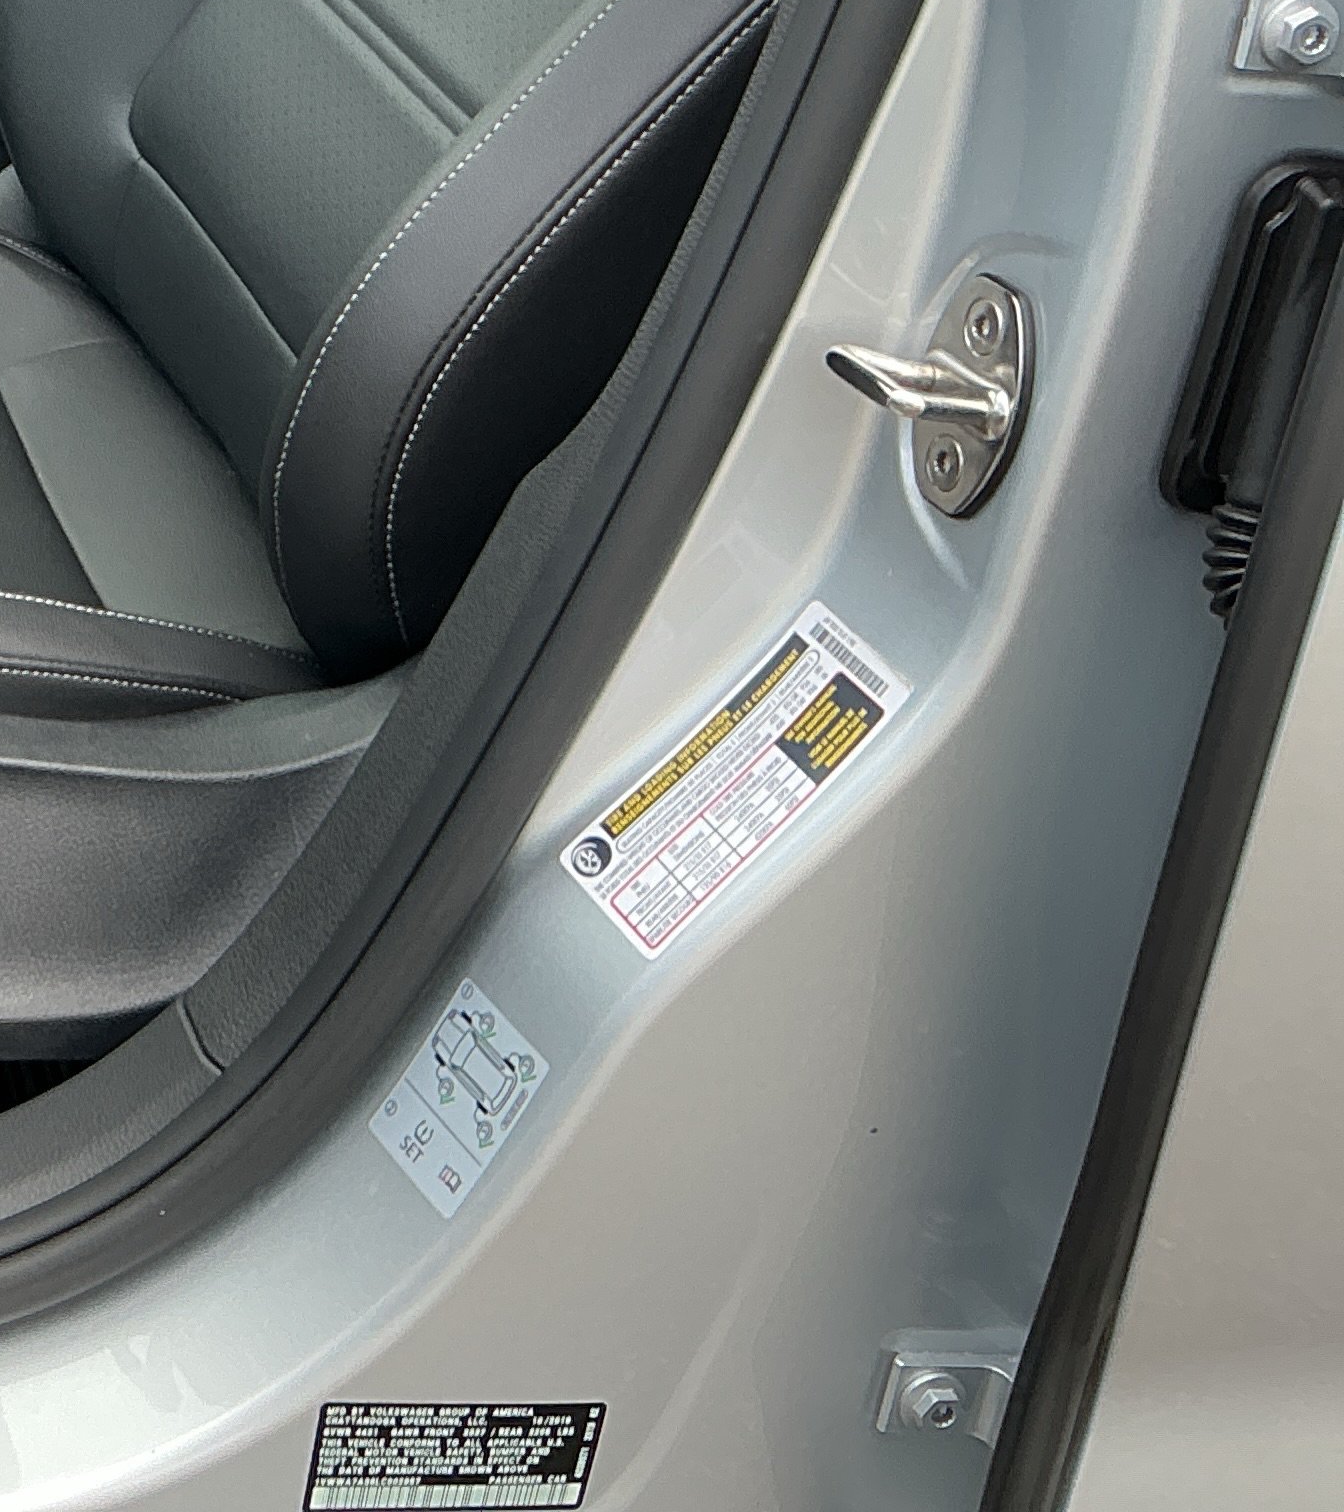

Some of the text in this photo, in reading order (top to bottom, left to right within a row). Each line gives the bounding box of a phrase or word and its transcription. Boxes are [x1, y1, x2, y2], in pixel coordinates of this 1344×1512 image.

[674, 706, 732, 763] INFORMATION
[399, 1135, 425, 1164] SET
[491, 1407, 535, 1416] AMERICA
